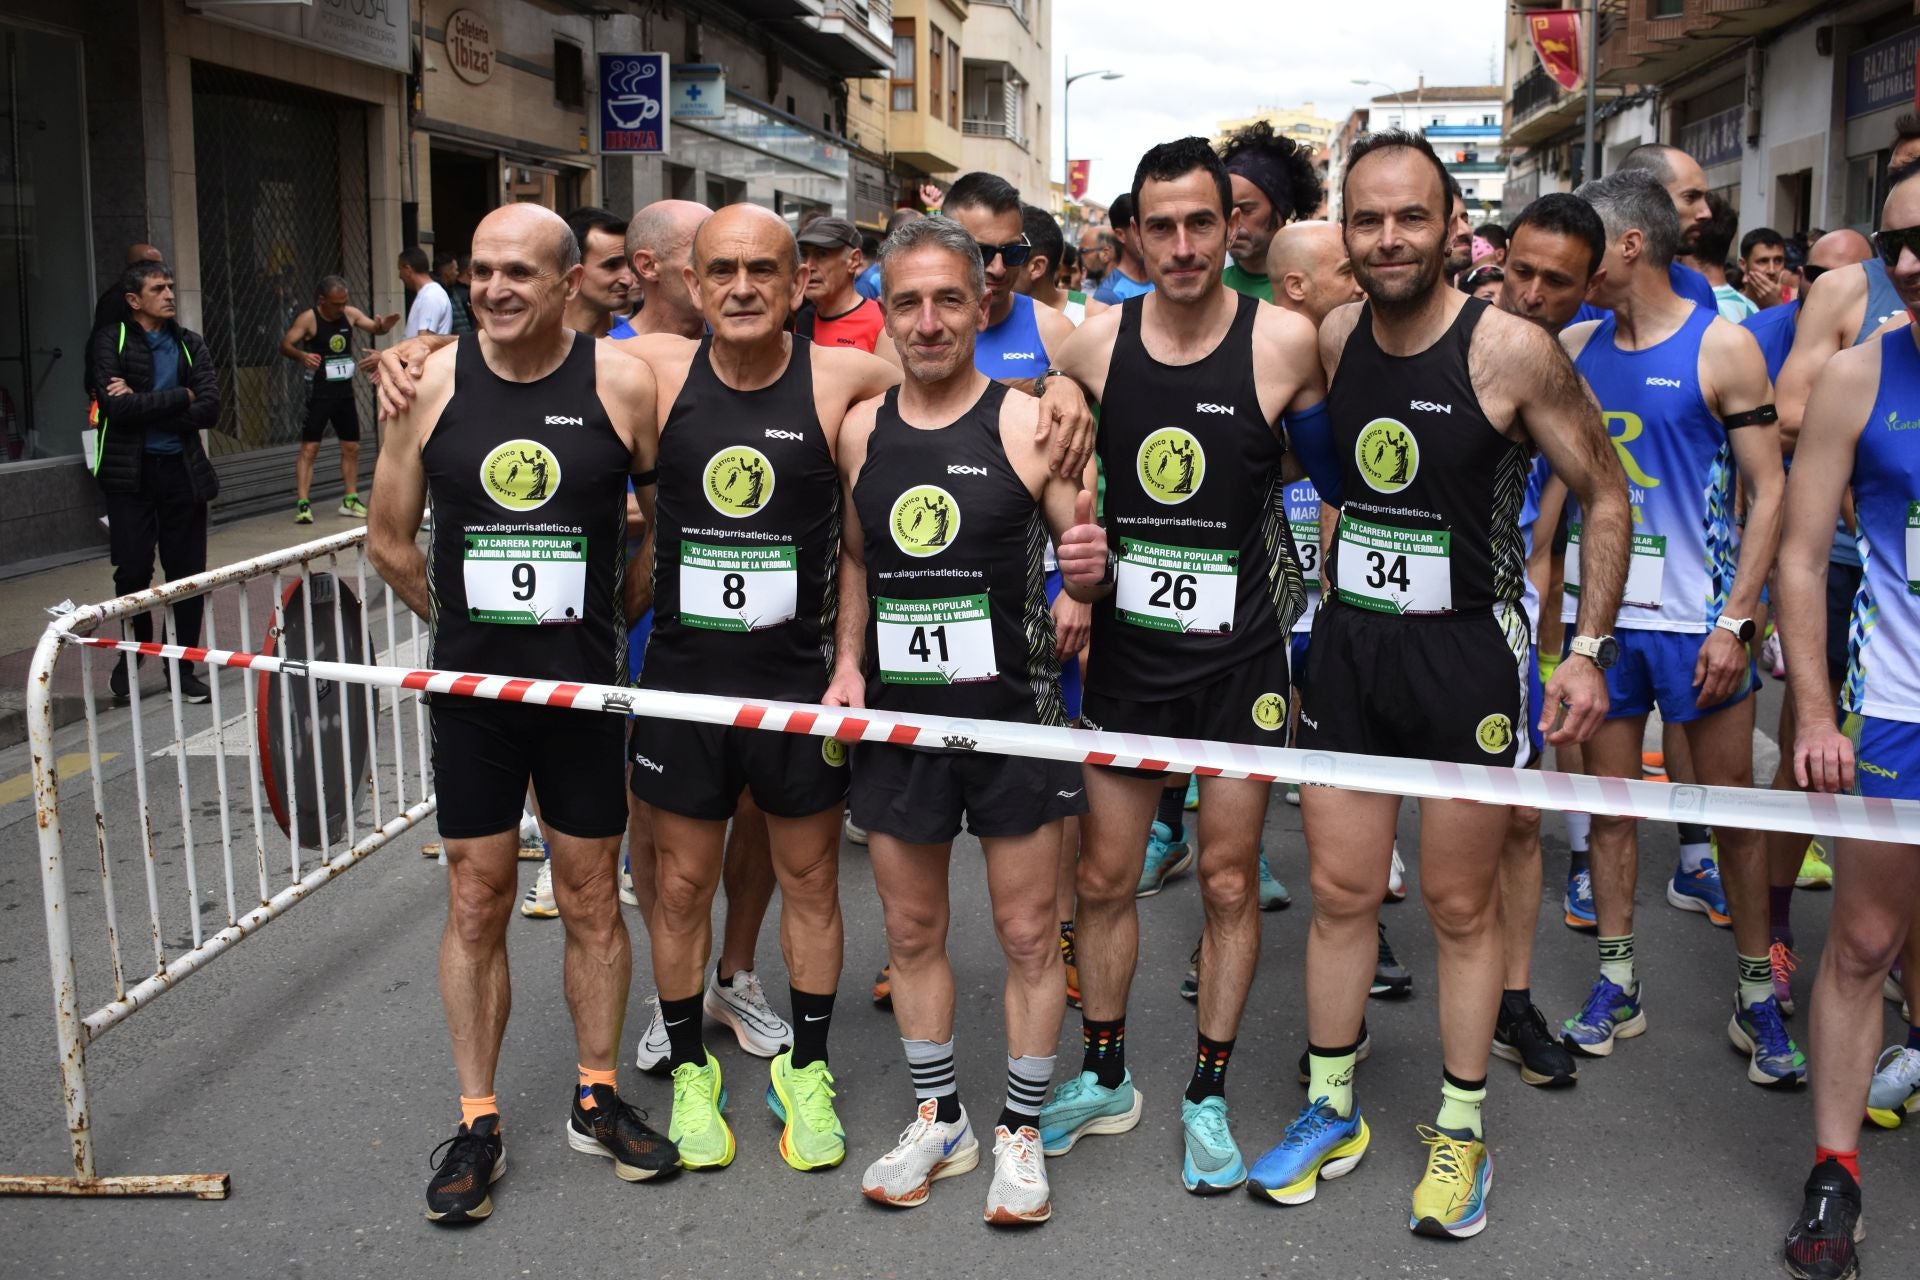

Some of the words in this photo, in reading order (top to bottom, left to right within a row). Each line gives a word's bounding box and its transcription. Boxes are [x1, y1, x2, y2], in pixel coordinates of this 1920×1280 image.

[1864, 46, 1896, 82] BAZAR
[606, 130, 658, 149] IBIZA
[336, 364, 346, 375] 11
[463, 522, 582, 534] www.calagurrisatletico.es
[1116, 516, 1226, 528] www.calagurrisatletico.es
[682, 526, 792, 542] www.calagurrisatletico.es
[1350, 522, 1358, 531] XV
[1360, 524, 1392, 538] CARRERA
[1394, 532, 1432, 542] POPULAR
[478, 539, 488, 548] XV
[490, 540, 530, 548] CARRERA
[532, 540, 572, 548] POPULAR
[1342, 530, 1370, 546] CALAHORRA
[1372, 538, 1392, 549] CIUDAD
[1394, 541, 1402, 550] DE
[1403, 542, 1412, 551] LA
[1412, 544, 1444, 554] VERDURA
[468, 550, 505, 558] CALAHORRA
[506, 550, 530, 558] CIUDAD
[532, 550, 540, 558] DE
[542, 551, 551, 559] LA
[552, 551, 582, 559] VERDURA
[692, 546, 700, 556] XV
[702, 548, 739, 558] CARRERA
[742, 550, 780, 558] POPULAR
[1132, 544, 1142, 552] XV
[1144, 546, 1182, 558] CARRERA
[1184, 552, 1223, 562] POPULAR
[684, 556, 716, 568] CALAHORRA
[716, 560, 740, 568] CIUDAD
[742, 560, 750, 569] DE
[751, 560, 760, 569] LA
[761, 560, 792, 568] VERDURA
[1158, 558, 1182, 568] CIUDAD
[1183, 562, 1192, 570] DE
[1193, 562, 1201, 570] LA
[1202, 564, 1232, 572] VERDURA
[878, 568, 983, 579] www.calagurrisatletico.es
[1366, 551, 1410, 592] 34
[512, 563, 536, 601] 9
[722, 573, 746, 610] 8
[1148, 571, 1197, 610] 26
[886, 602, 894, 610] XV
[896, 603, 931, 612] CARRERA
[932, 600, 972, 611] POPULAR
[880, 612, 910, 622] CALAHORRA
[910, 613, 933, 622] CIUDAD
[934, 613, 942, 621] DE
[944, 612, 952, 620] LA
[954, 609, 984, 620] VERDURA
[908, 626, 950, 662] 41
